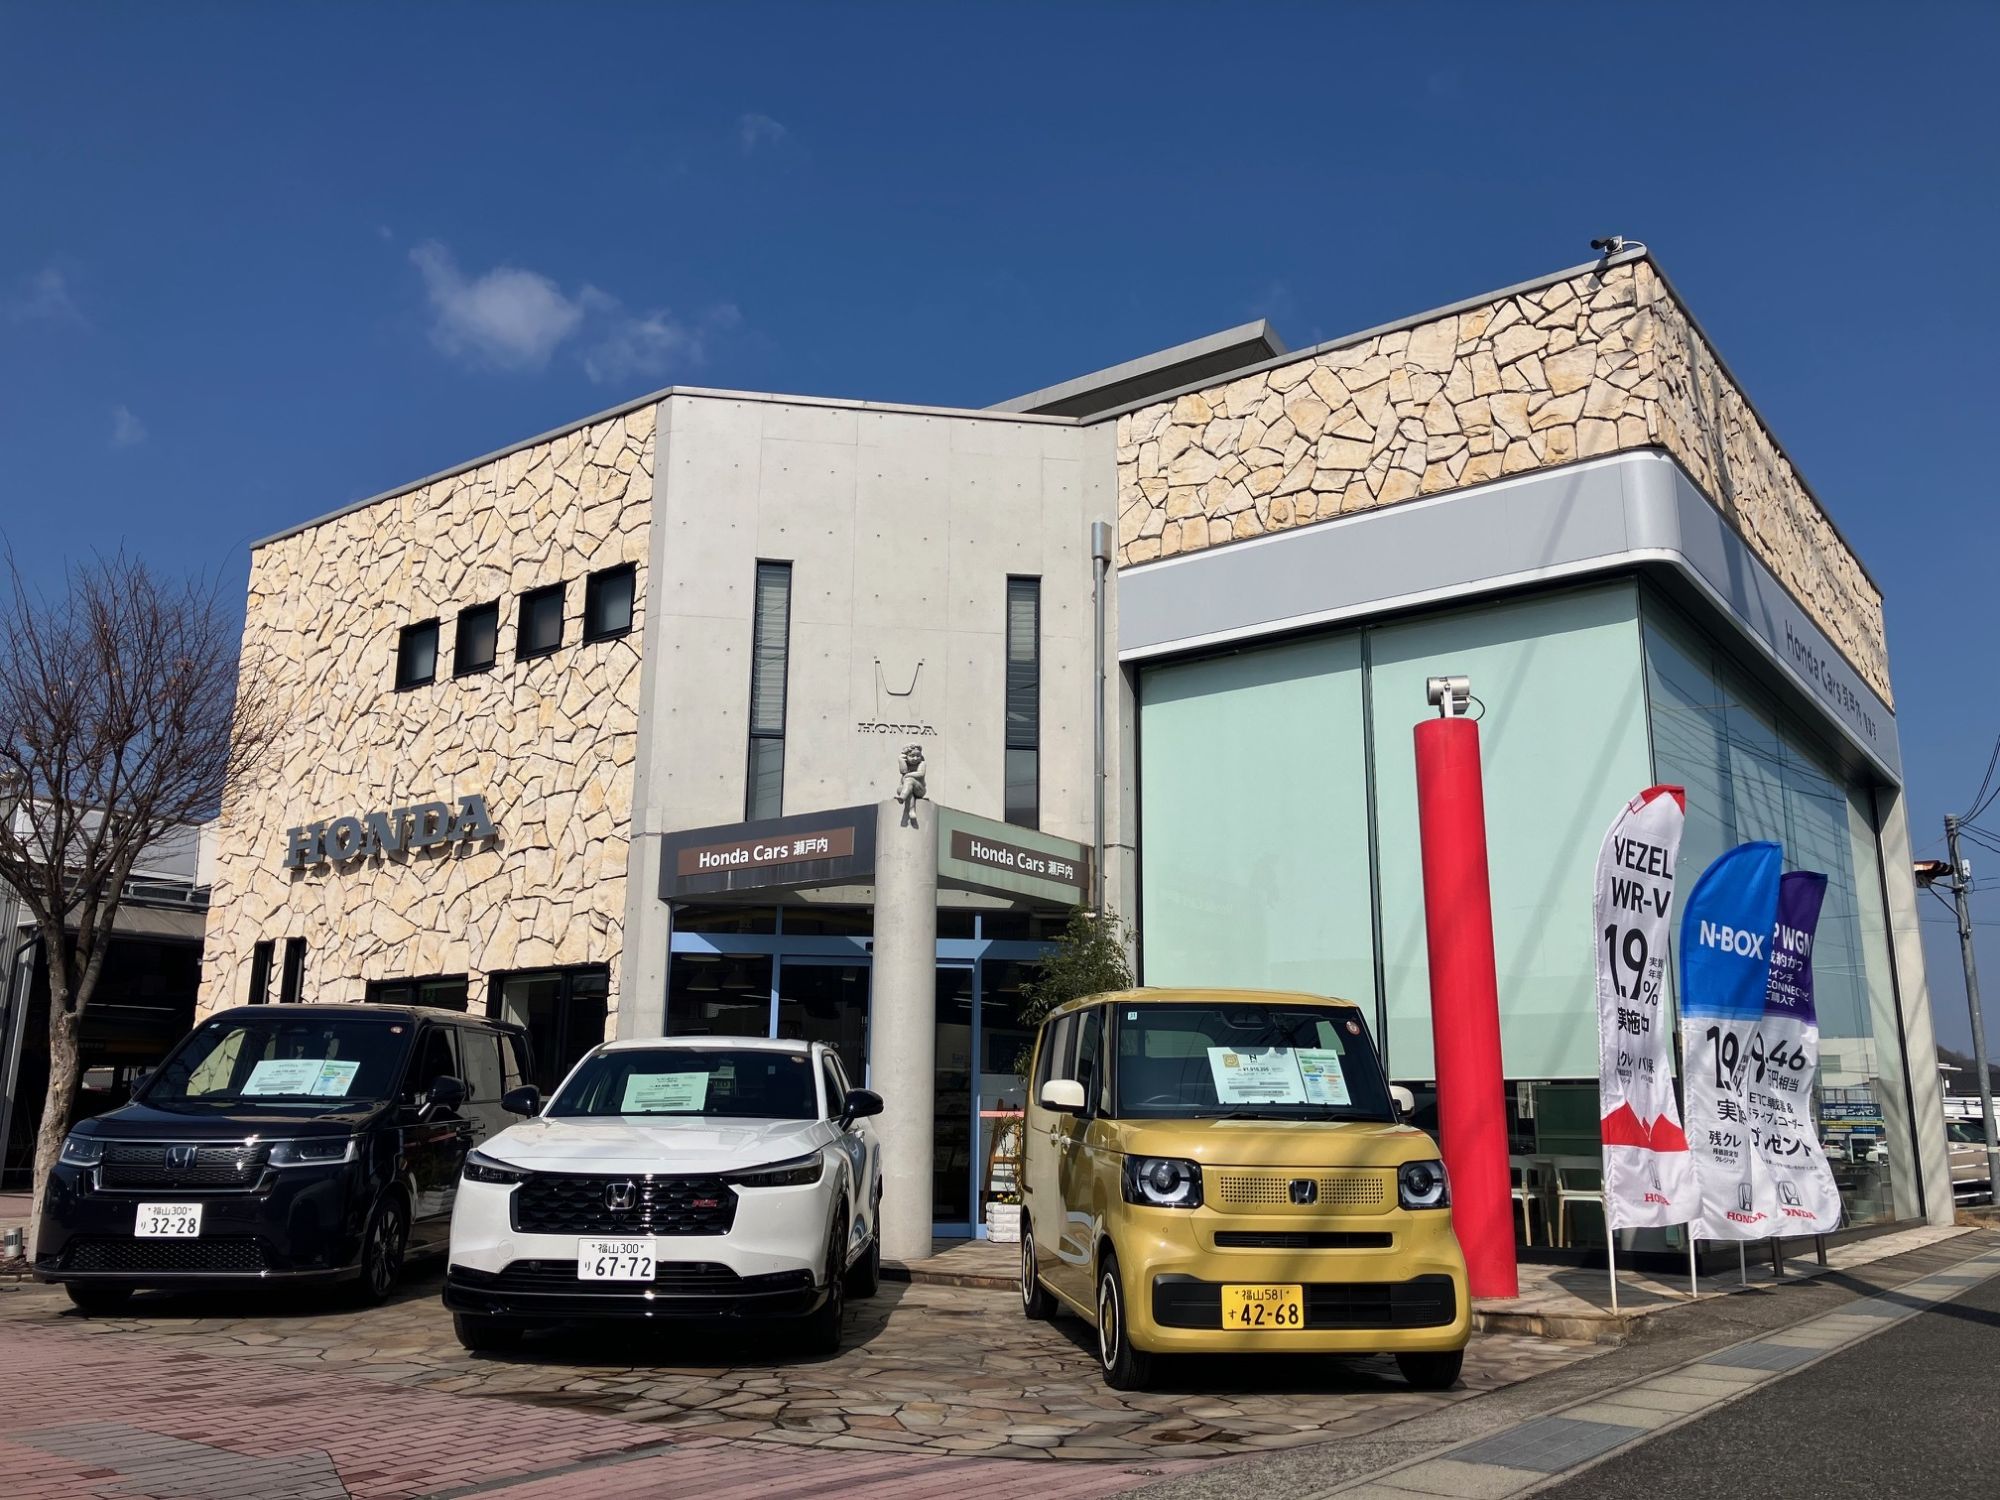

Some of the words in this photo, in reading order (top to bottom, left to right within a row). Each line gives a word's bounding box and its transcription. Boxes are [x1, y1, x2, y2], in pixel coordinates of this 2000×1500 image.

[1785, 620, 1819, 681] Honda
[1821, 660, 1842, 705] Cars
[858, 722, 938, 736] HONDA
[283, 793, 498, 868] HONDA
[698, 847, 750, 869] Honda
[752, 843, 789, 862] Cars
[793, 838, 829, 857] 瀬戸内
[969, 839, 1015, 866] Honda
[1016, 851, 1045, 874] Cars
[1047, 860, 1074, 880] 瀬戸内
[1614, 835, 1673, 881] VEZEL
[1611, 876, 1671, 919] WR-V
[1699, 920, 1766, 961] N-BOX
[1617, 1007, 1650, 1036] 実施中
[1708, 1129, 1742, 1149] 残クレ
[152, 1205, 188, 1217] 福山300
[149, 1216, 197, 1235] 32-28
[598, 1243, 639, 1254] 福山300
[595, 1256, 651, 1278] 67-72
[1242, 1288, 1283, 1301] 福山581
[1240, 1303, 1299, 1326] 42-68
